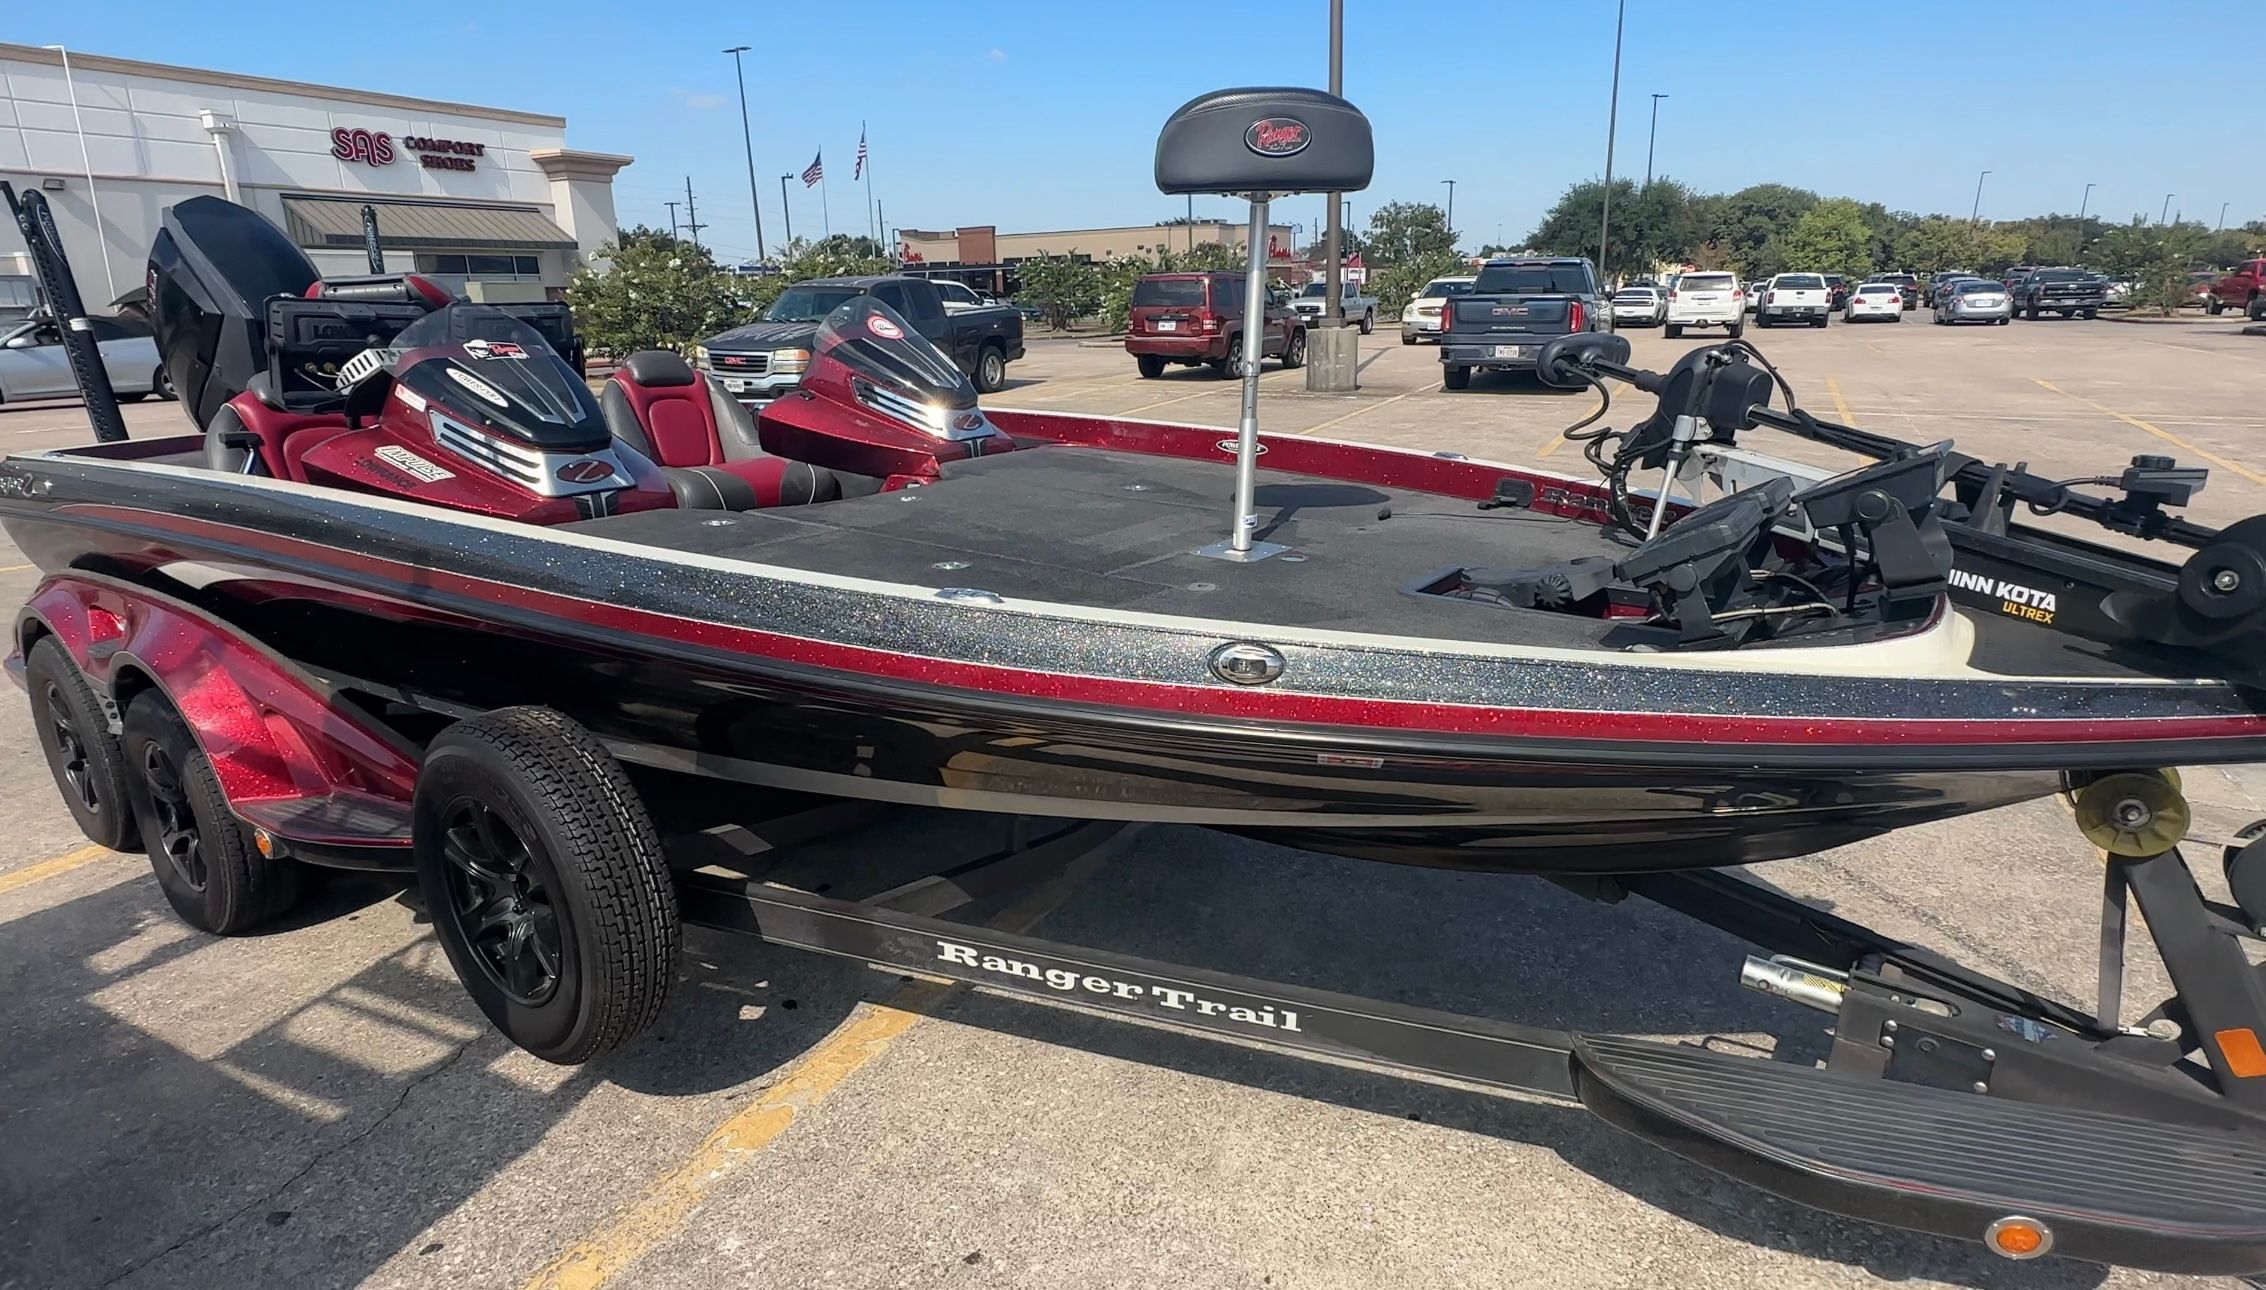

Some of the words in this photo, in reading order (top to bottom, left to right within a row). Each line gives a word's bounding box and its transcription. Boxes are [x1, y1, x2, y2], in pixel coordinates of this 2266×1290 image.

[331, 127, 396, 167] SAS
[404, 136, 485, 156] COMFORT
[420, 154, 476, 171] SHOES
[1492, 307, 1529, 316] GMC
[725, 356, 747, 365] GMC
[1948, 568, 1995, 595] INN
[1995, 581, 2056, 612] KOTA
[2002, 601, 2055, 624] ULTREX
[936, 941, 1144, 1000] Ranger
[1151, 985, 1302, 1032] Trail
